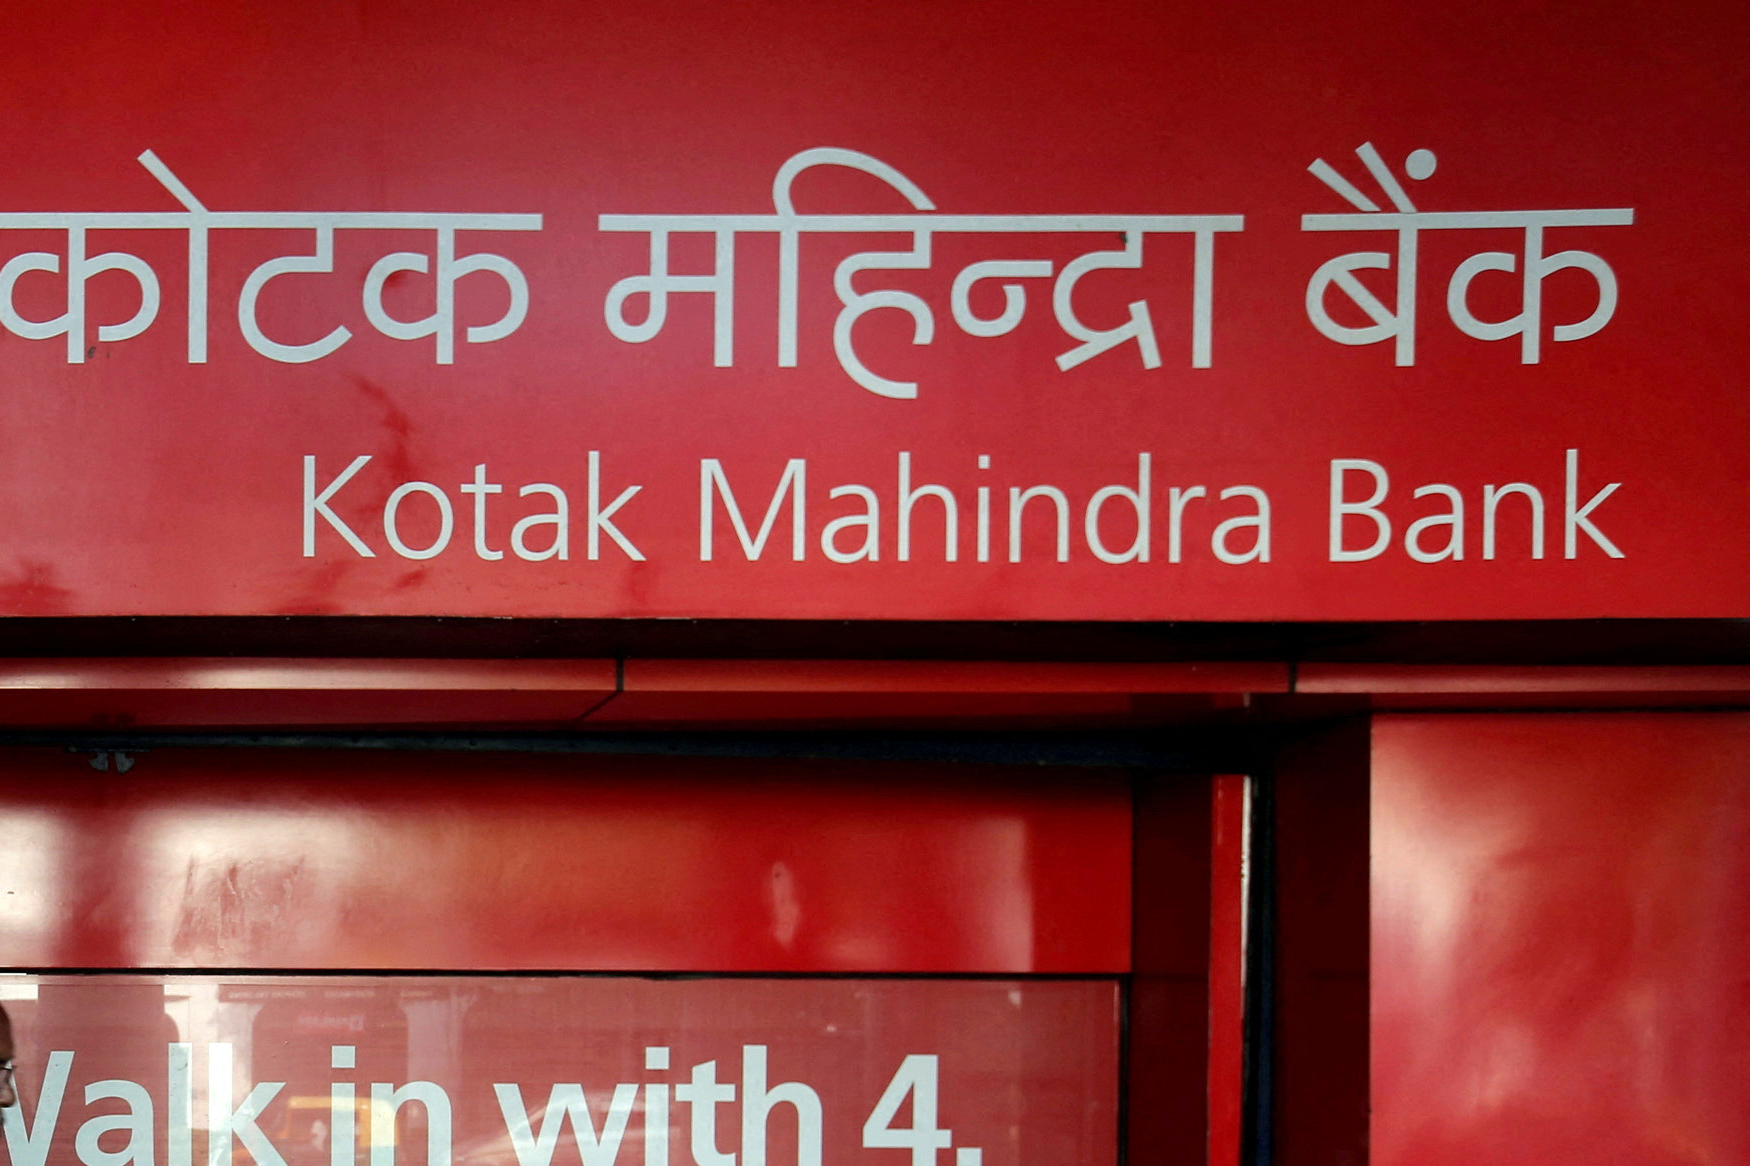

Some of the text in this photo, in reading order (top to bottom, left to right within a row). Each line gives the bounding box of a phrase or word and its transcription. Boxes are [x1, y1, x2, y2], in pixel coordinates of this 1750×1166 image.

[598, 146, 1244, 400] महिन्द्रा
[1301, 141, 1634, 367] बैंक
[302, 448, 1626, 565] Kotak Mahindra Bank
